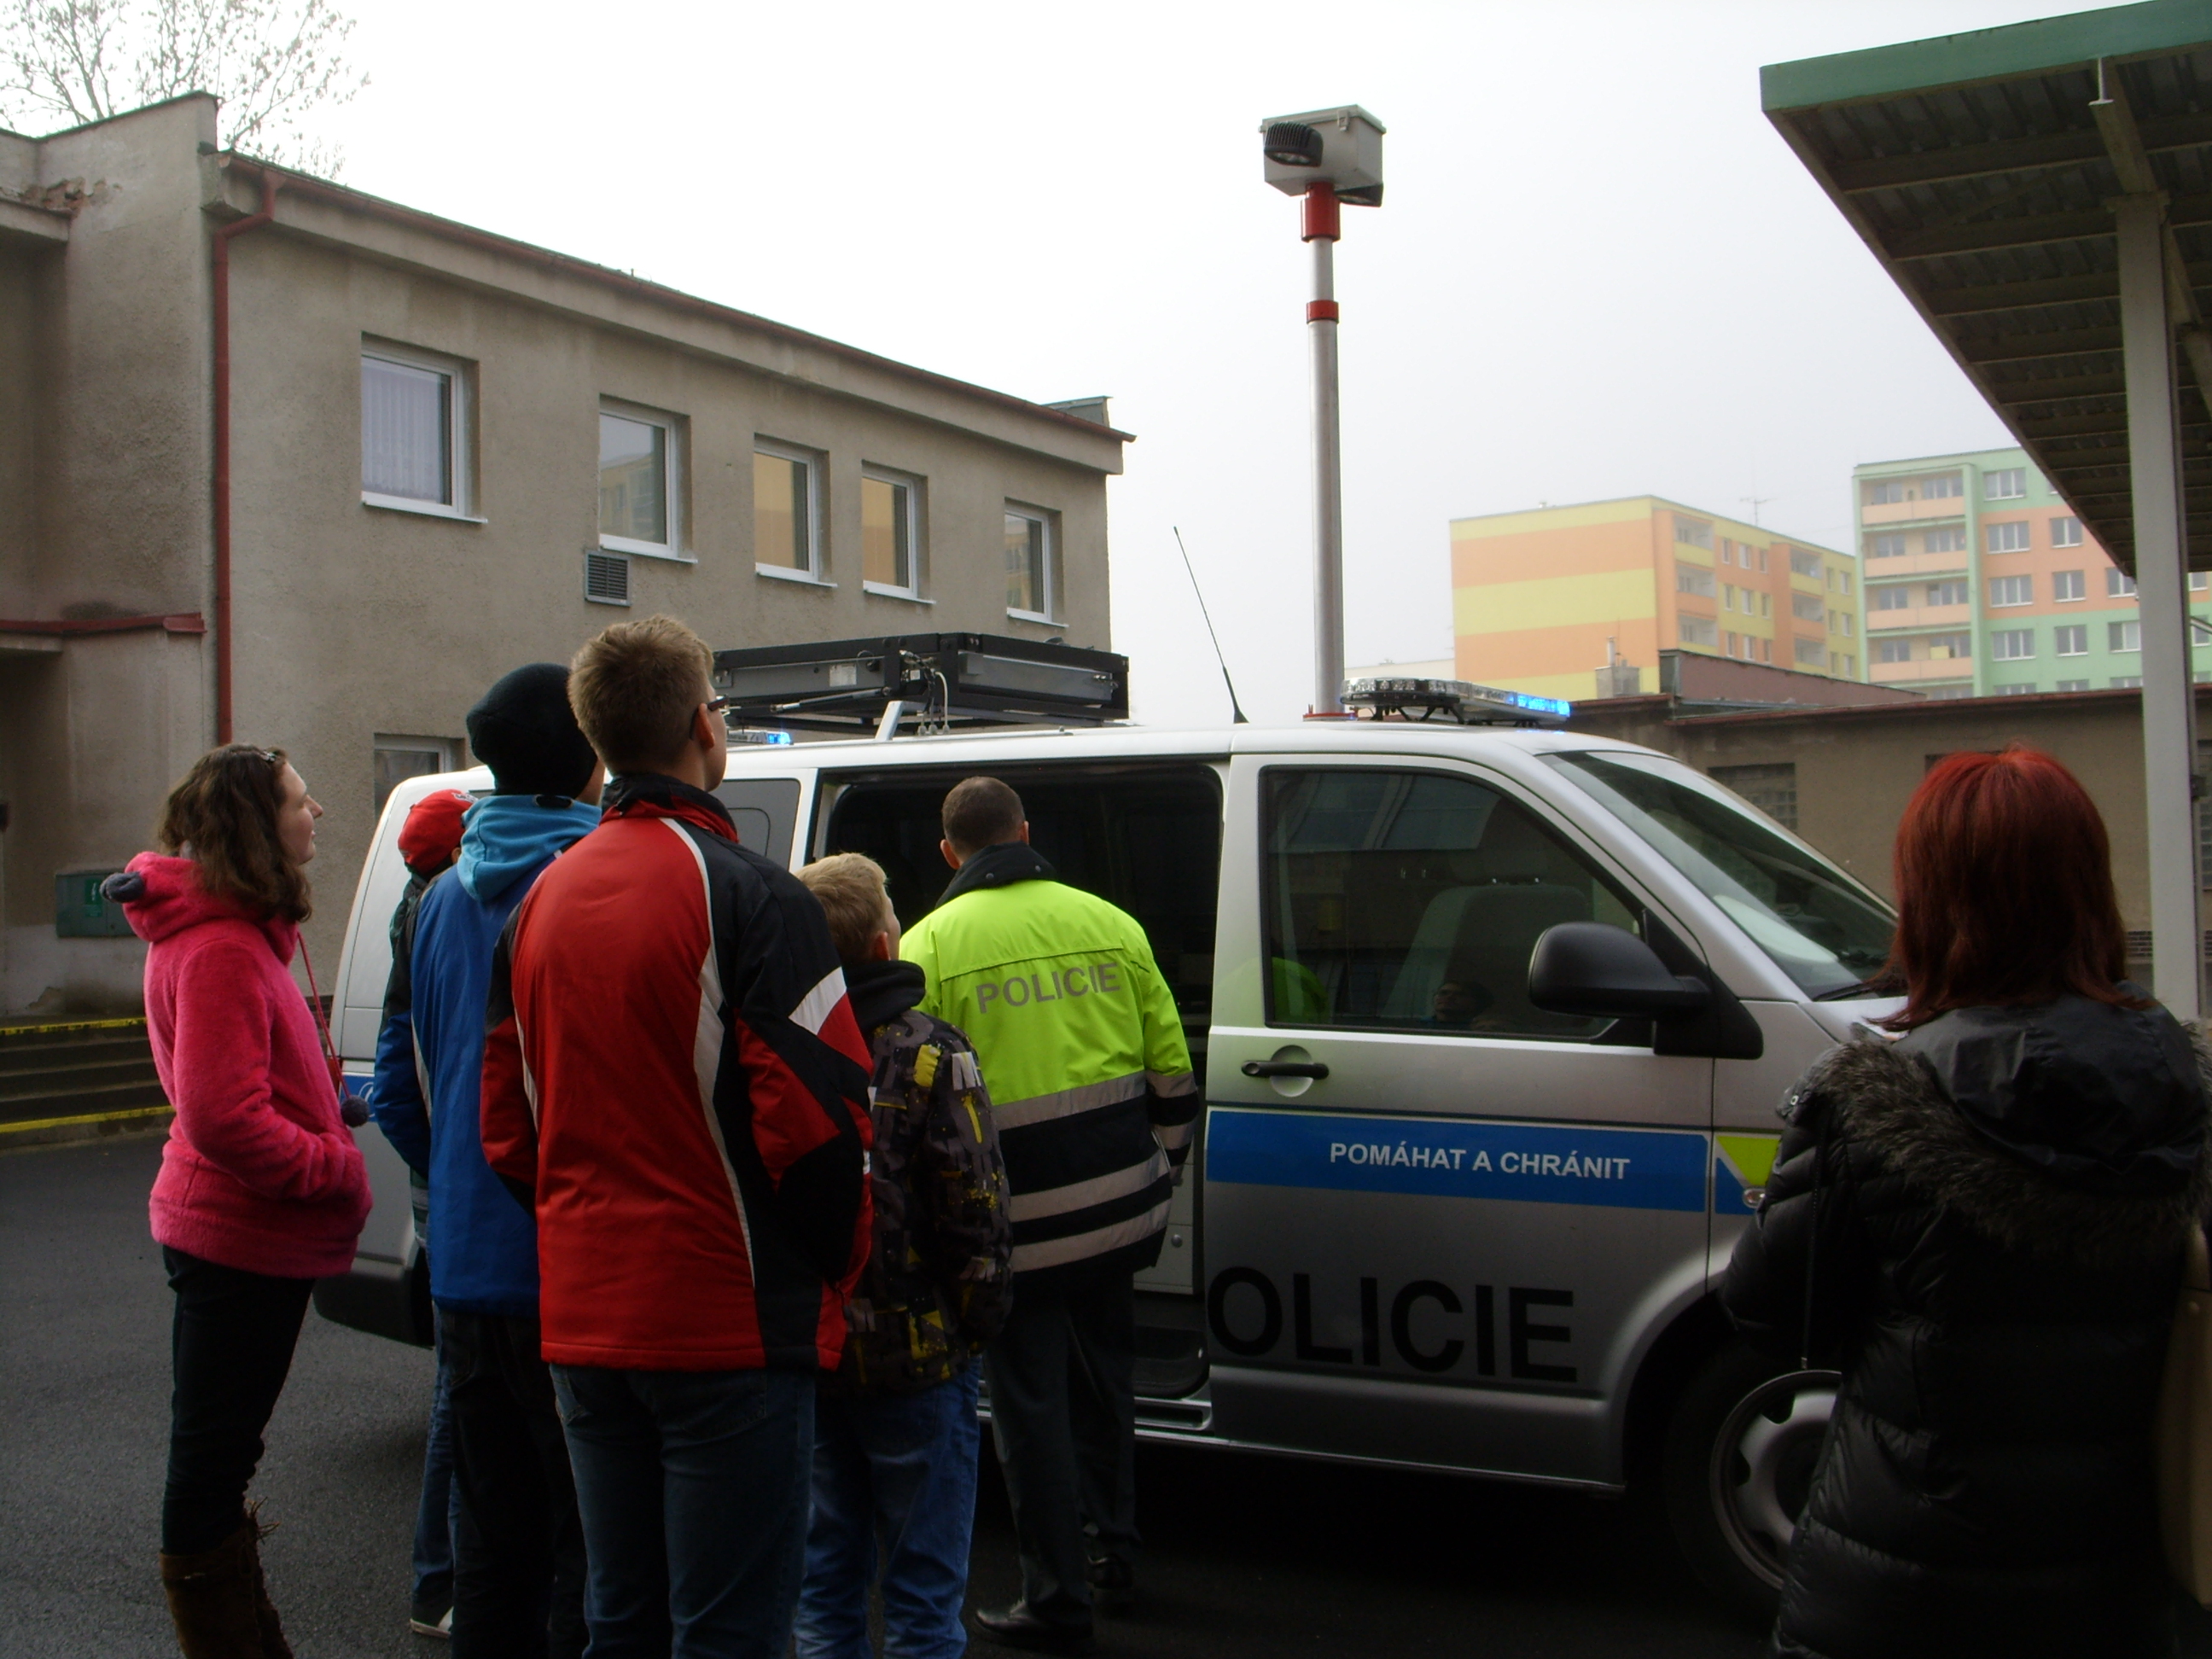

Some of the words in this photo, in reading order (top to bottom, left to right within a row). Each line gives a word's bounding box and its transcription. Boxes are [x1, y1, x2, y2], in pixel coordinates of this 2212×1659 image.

[975, 962, 1121, 1014] POLICIE
[1330, 1141, 1466, 1170] POMÁHAT
[1472, 1150, 1493, 1172] A
[1500, 1151, 1631, 1179] CHRÁNIT
